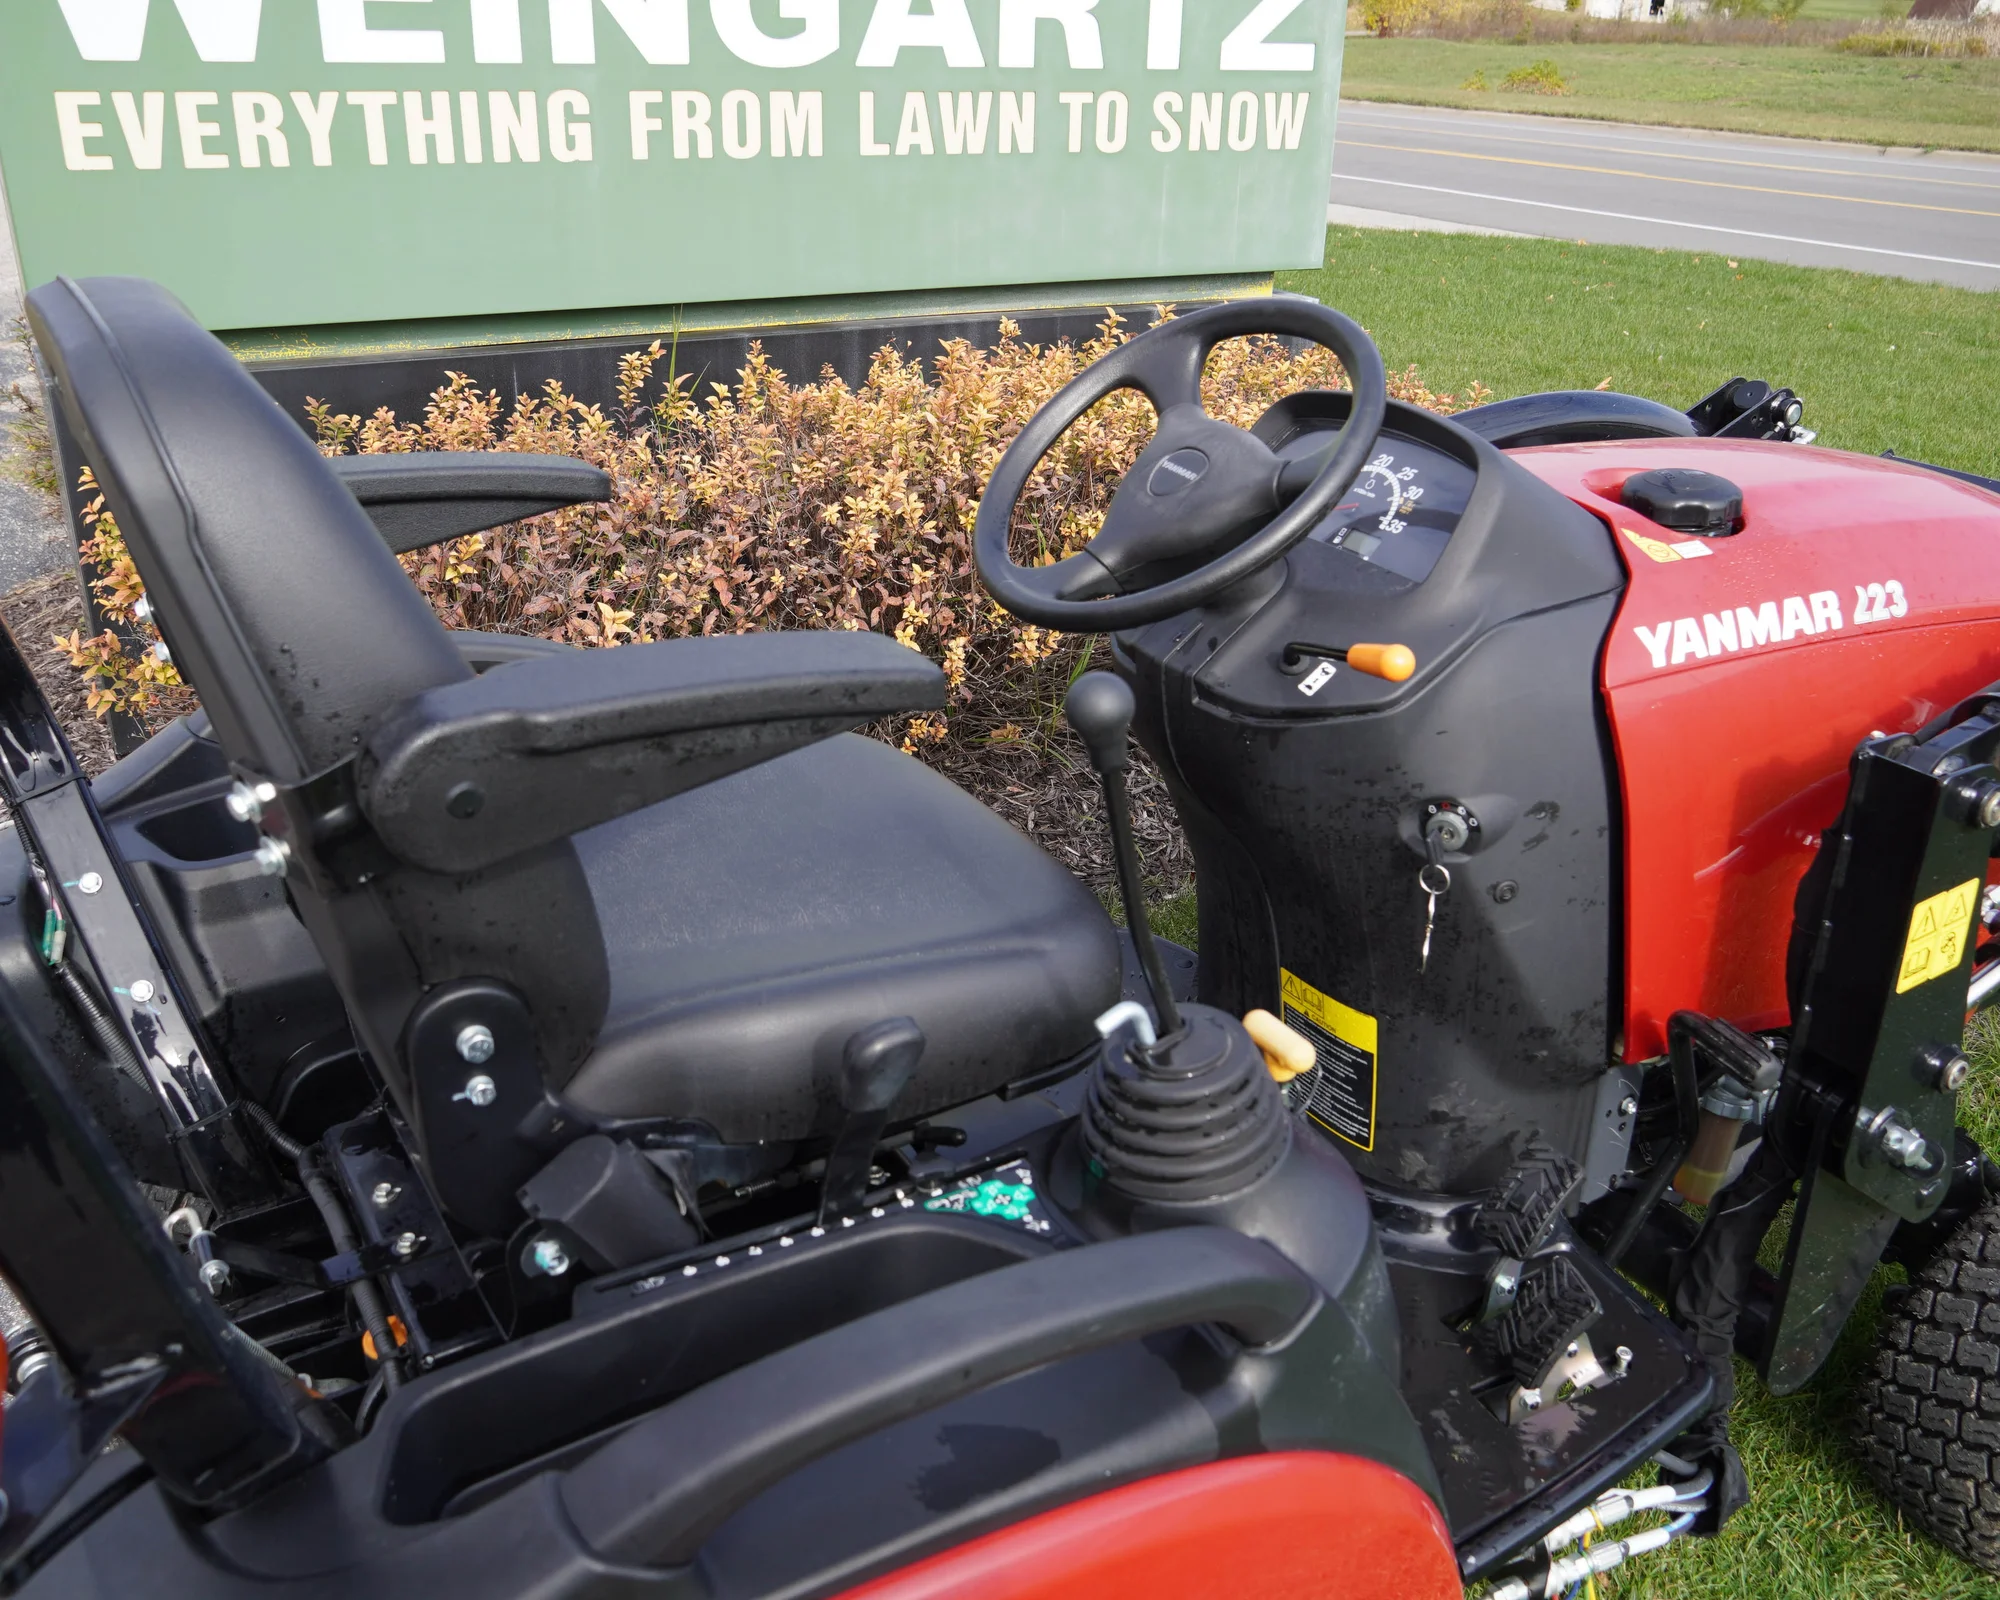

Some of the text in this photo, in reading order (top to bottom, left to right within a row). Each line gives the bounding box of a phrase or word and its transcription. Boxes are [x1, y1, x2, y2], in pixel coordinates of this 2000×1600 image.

[54, 89, 1310, 170] EVERYTHING FROM LAWN TO SNOW
[1372, 453, 1394, 468] 20
[1161, 459, 1198, 481] YANMAR
[1396, 466, 1419, 481] 25
[1402, 485, 1424, 500] 30
[1385, 519, 1407, 534] 35
[1633, 590, 1843, 669] YANMAR
[1311, 1014, 1337, 1033] CAUTION
